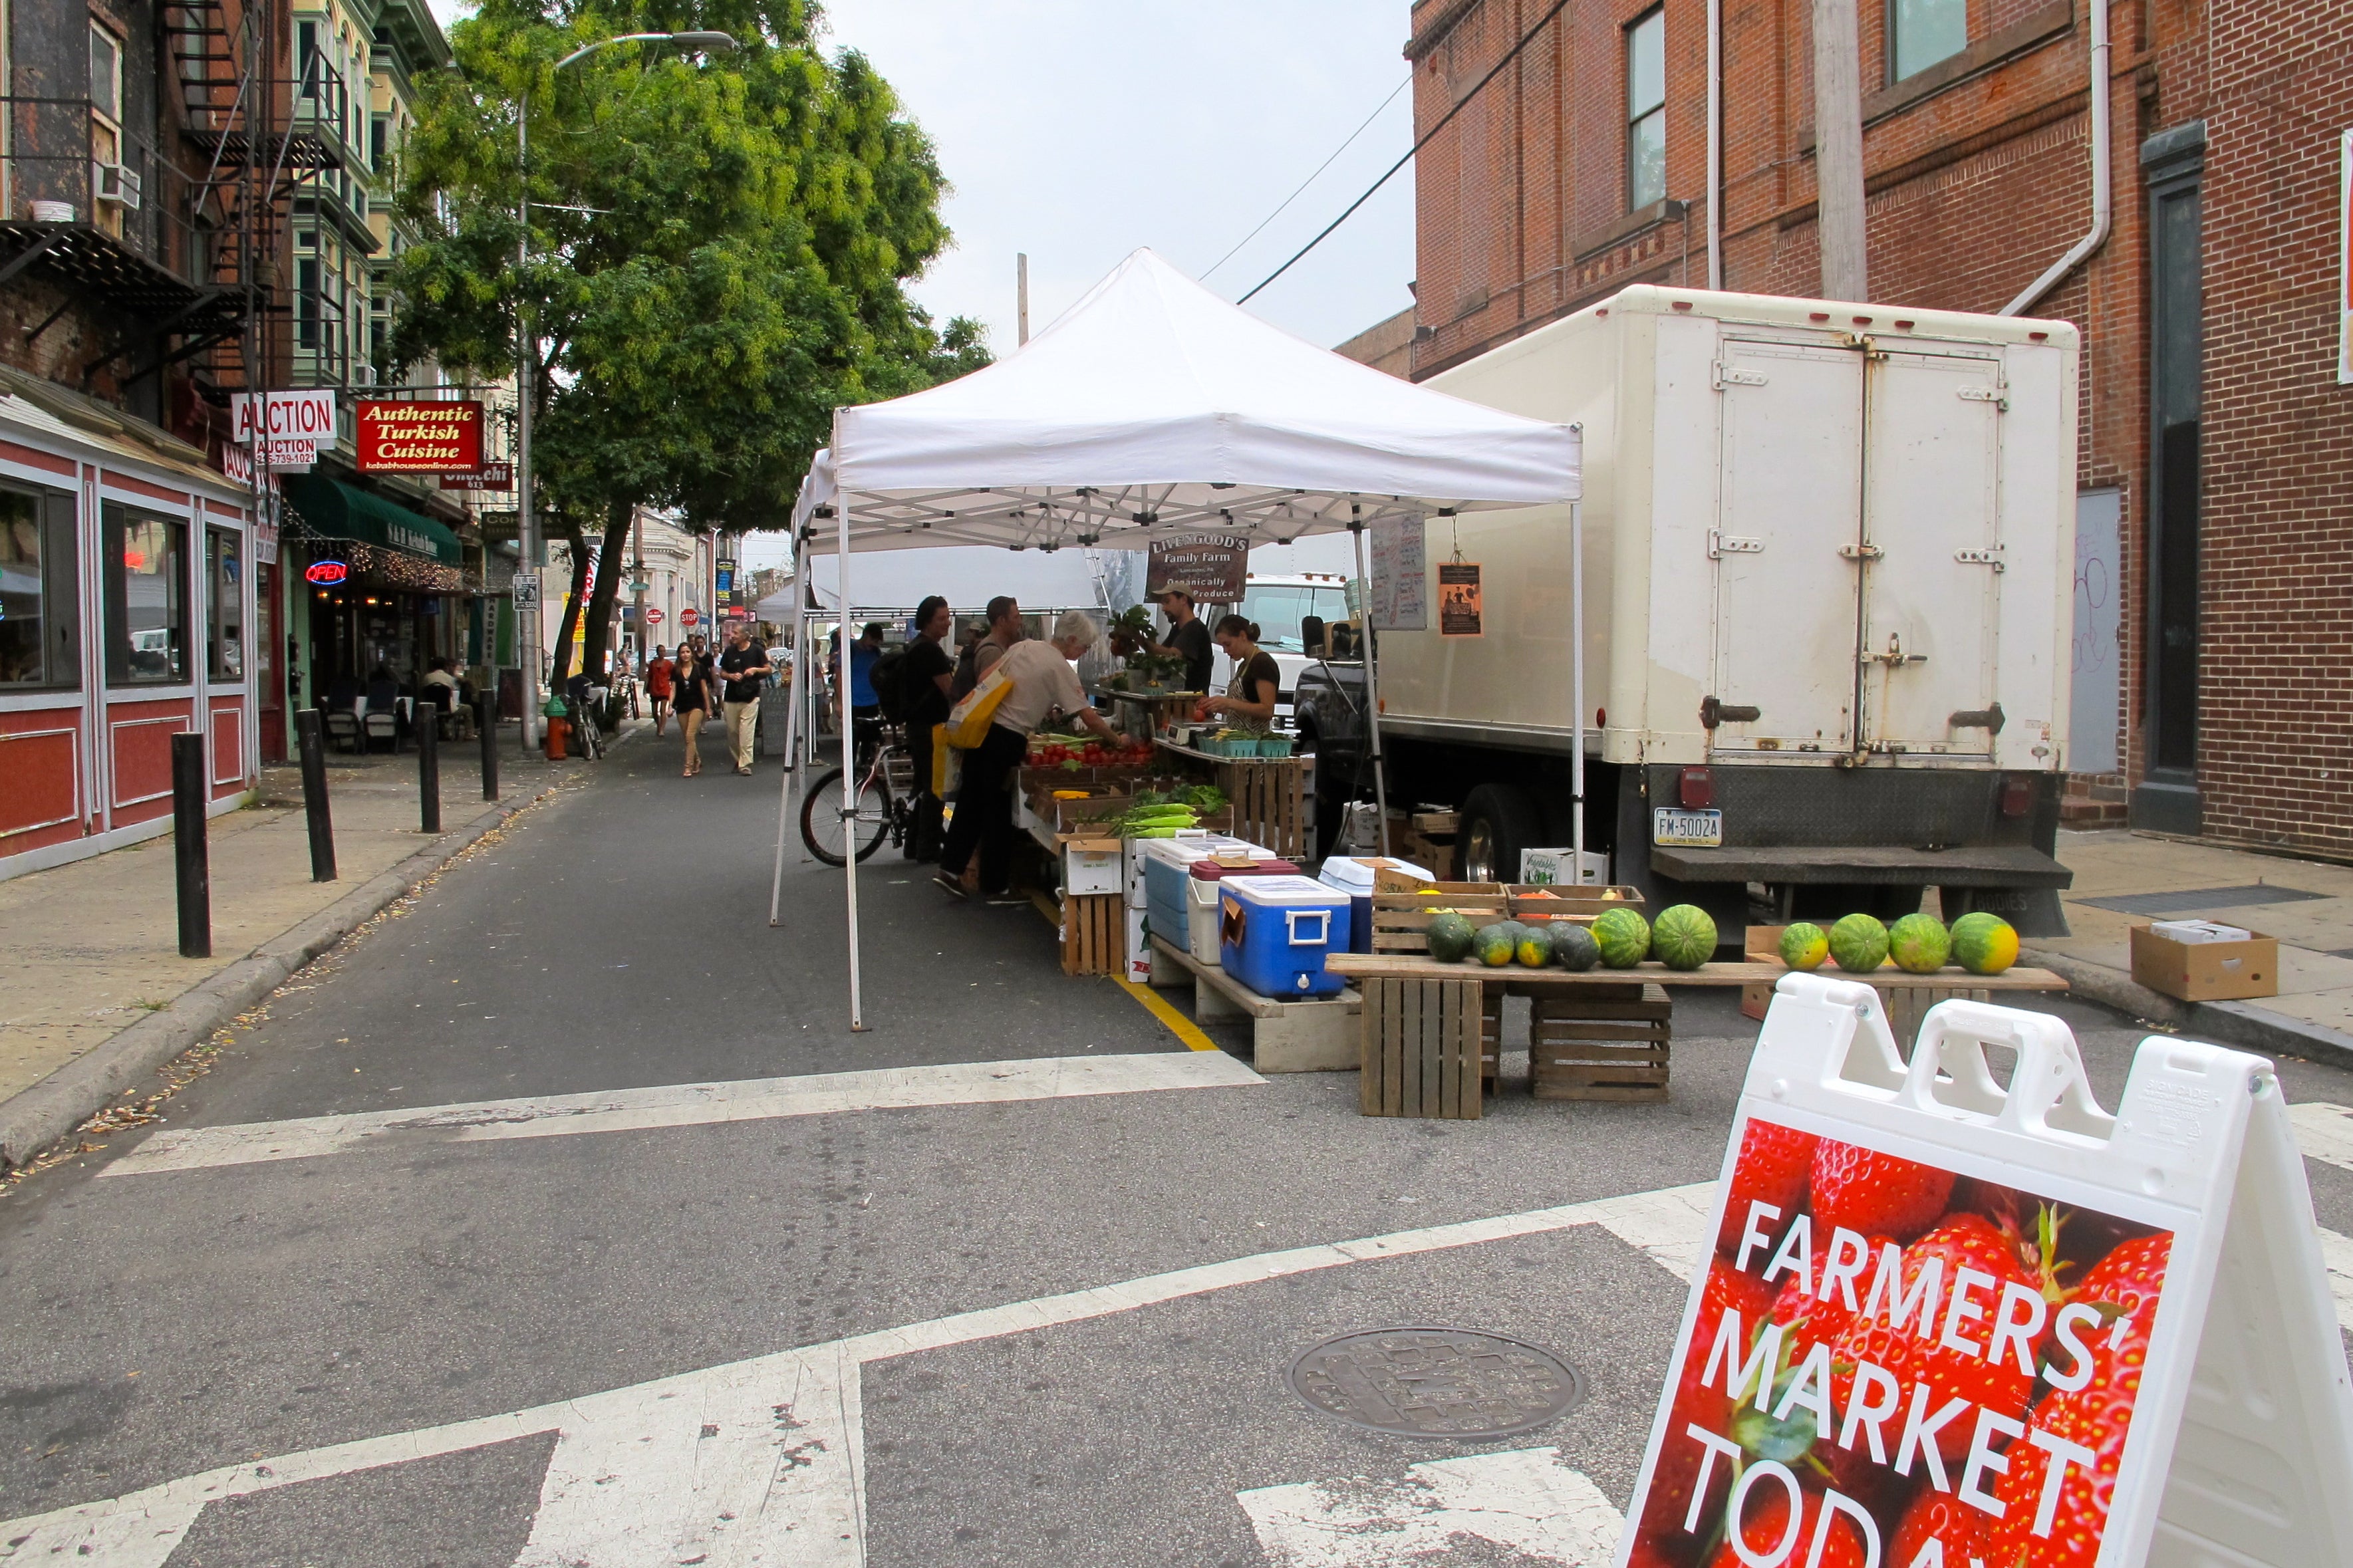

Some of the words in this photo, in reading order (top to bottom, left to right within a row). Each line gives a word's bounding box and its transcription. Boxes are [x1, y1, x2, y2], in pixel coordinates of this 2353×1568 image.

[240, 400, 331, 436] AUCTION
[363, 406, 474, 421] Authentic
[377, 424, 460, 440] Turkish
[377, 442, 460, 459] Cuisine
[257, 454, 315, 464] 25-739-1021
[366, 461, 472, 470] kebabhouseonline.com
[1165, 553, 1198, 565] Family
[1202, 552, 1230, 562] Farm
[306, 565, 347, 581] OPEN
[681, 613, 698, 622] STOP
[1659, 818, 1717, 837] FM-5002A
[1976, 893, 2028, 911] BODIES
[1735, 1200, 2131, 1392] FARMERS'
[1701, 1307, 2096, 1539] MARKET
[1683, 1423, 1984, 1568] TOD
